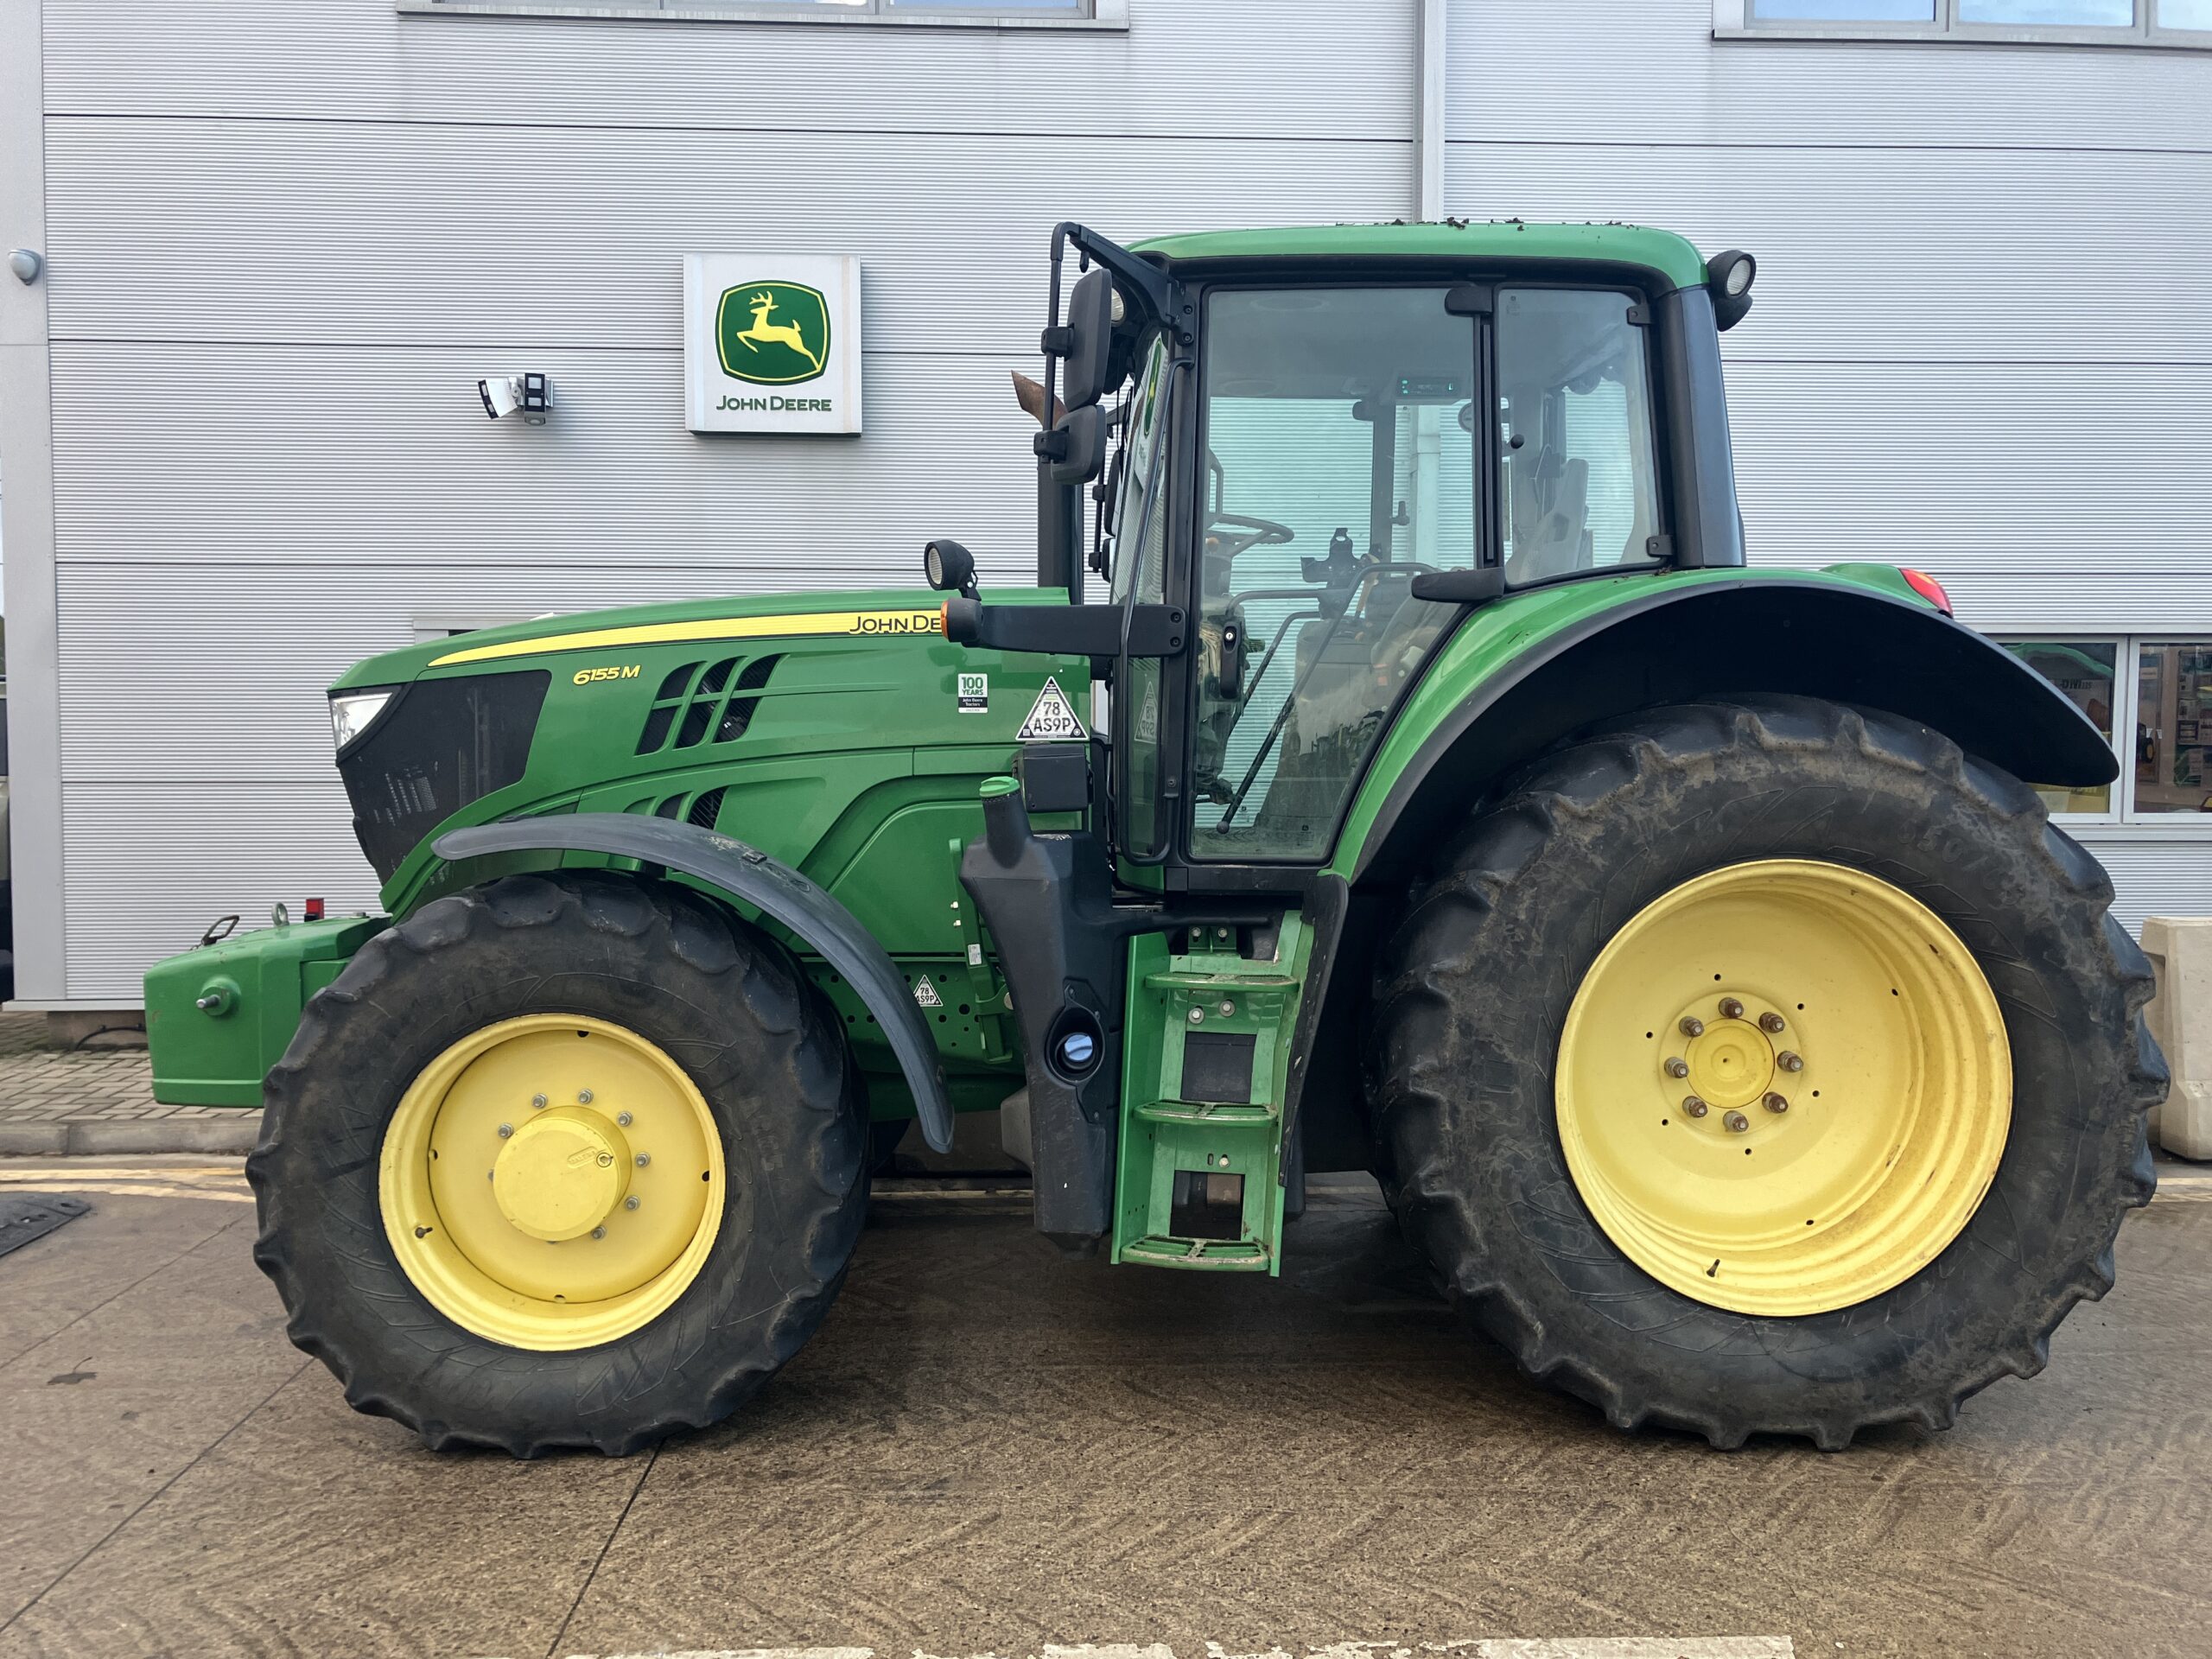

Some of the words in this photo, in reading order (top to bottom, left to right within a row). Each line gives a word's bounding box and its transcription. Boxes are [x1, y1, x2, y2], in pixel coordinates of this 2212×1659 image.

[716, 395, 766, 410] JOHN
[770, 396, 832, 411] DEERE
[849, 616, 908, 632] JOHN
[573, 667, 621, 685] 6155
[621, 664, 641, 678] M
[961, 677, 983, 689] 100
[1043, 702, 1060, 716] 78
[1033, 718, 1071, 732] AS9P
